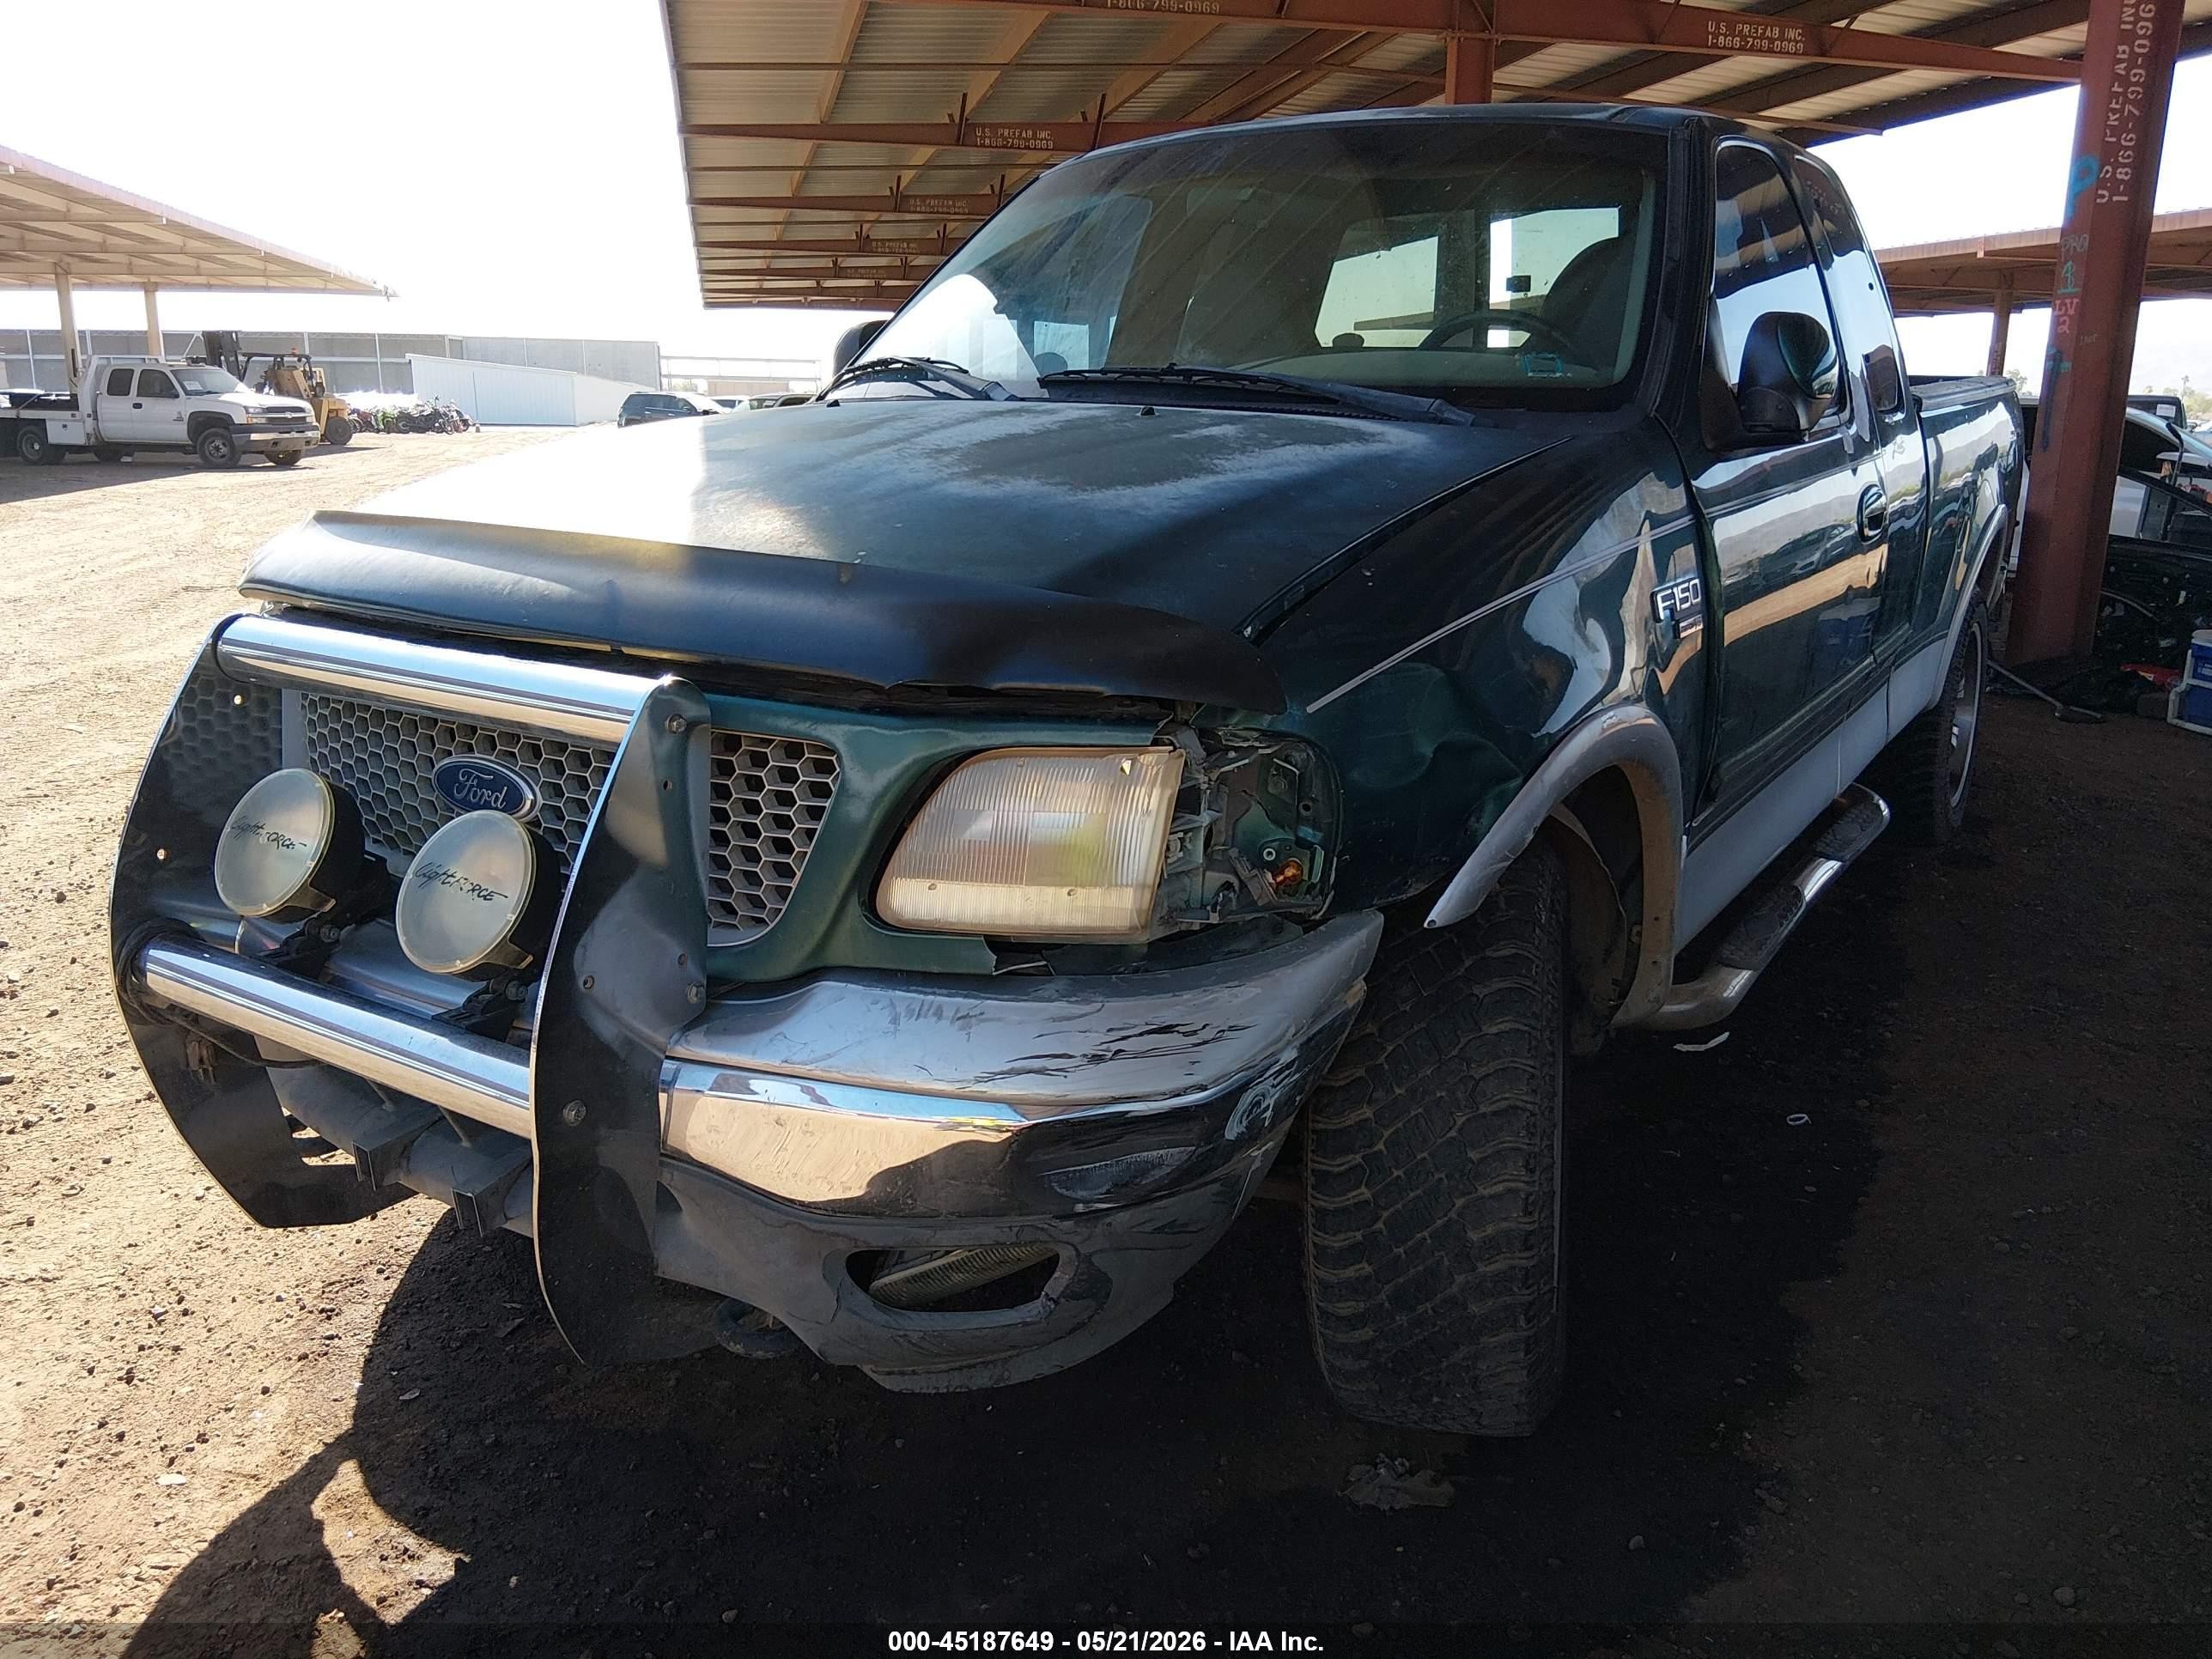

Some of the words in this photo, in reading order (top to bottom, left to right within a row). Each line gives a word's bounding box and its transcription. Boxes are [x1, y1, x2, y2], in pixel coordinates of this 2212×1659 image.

[1708, 20, 1729, 34] U.S.
[1735, 23, 1779, 38] PREFAB
[1784, 28, 1806, 41] INC.
[1708, 34, 1803, 53] 1-866-799-0969
[998, 129, 1033, 138] PREFAB
[2096, 158, 2114, 204] U.S.
[453, 769, 507, 809] Ford
